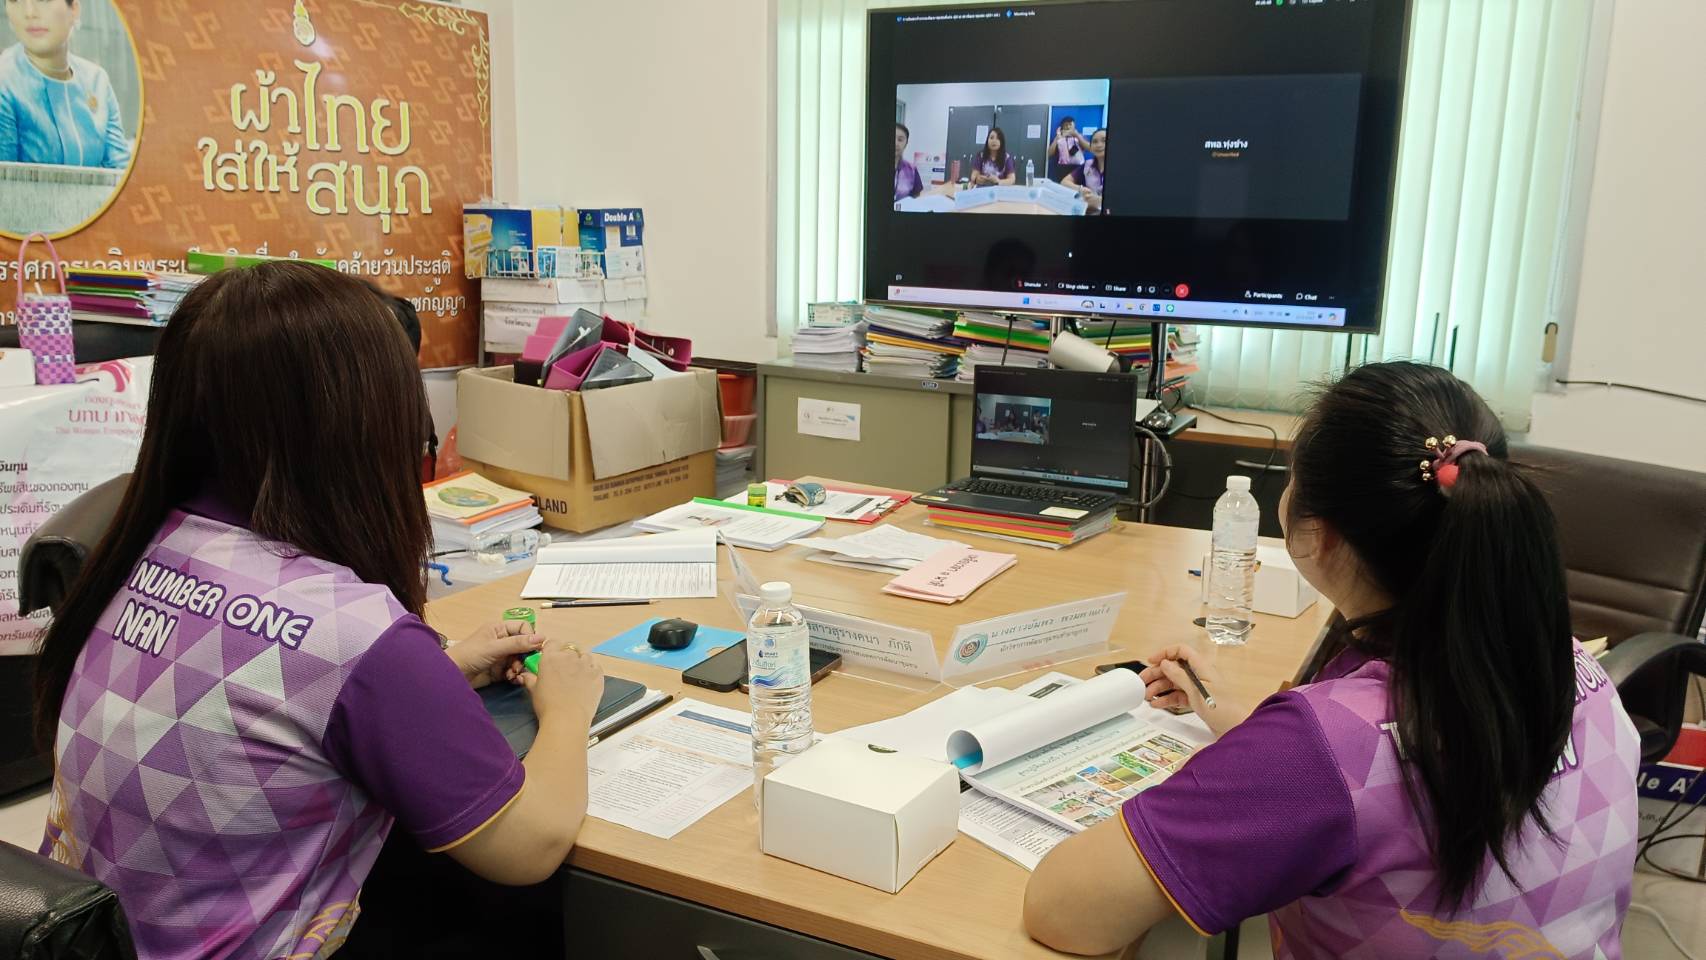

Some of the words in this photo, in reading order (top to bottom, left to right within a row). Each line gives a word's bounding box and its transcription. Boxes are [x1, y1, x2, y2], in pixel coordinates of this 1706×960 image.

[230, 58, 411, 156] ผ้าไทย
[604, 212, 627, 222] Double
[628, 212, 634, 222] A
[405, 286, 466, 318] ชกัญญา
[113, 599, 178, 657] NAN
[130, 558, 225, 619] NUMBER
[224, 595, 313, 649] ONE
